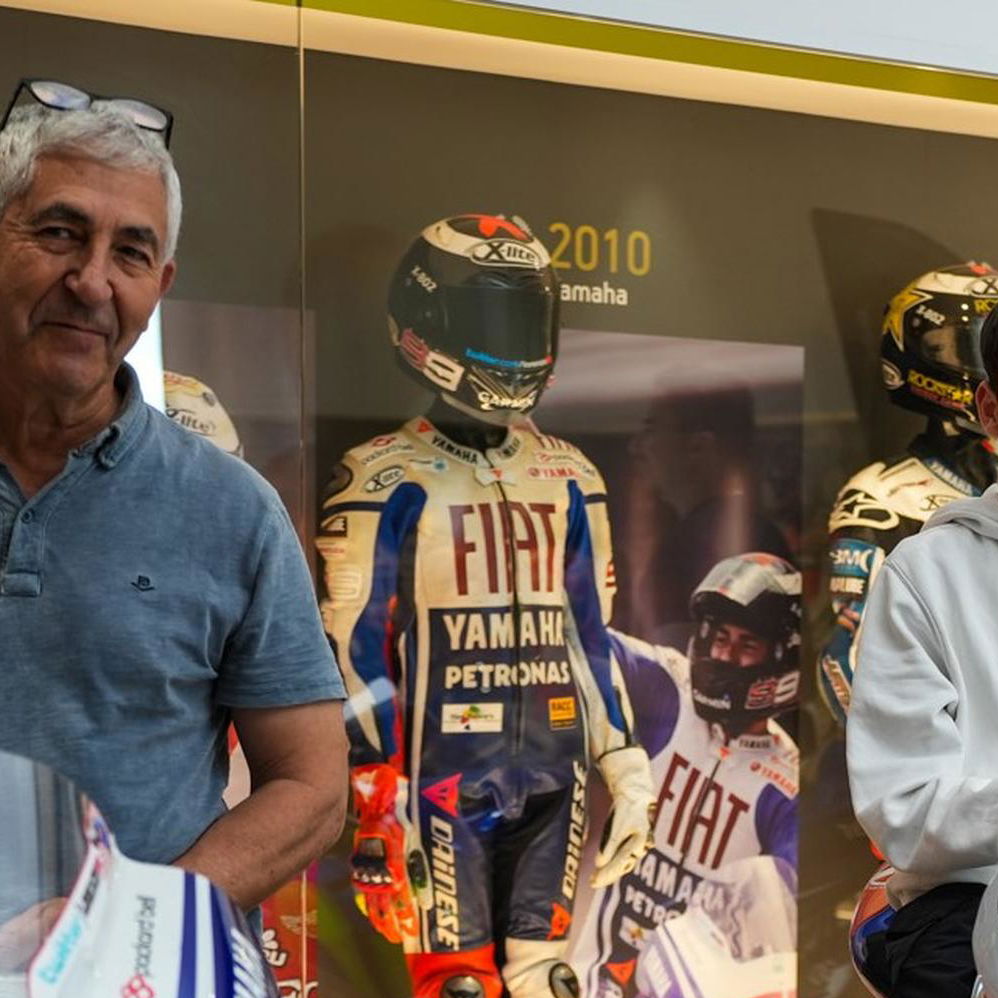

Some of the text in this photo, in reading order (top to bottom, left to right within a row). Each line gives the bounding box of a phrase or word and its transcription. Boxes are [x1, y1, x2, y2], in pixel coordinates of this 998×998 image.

[547, 222, 651, 277] 2010
[560, 282, 629, 306] amaha
[431, 436, 479, 465] YAMAHA
[448, 501, 556, 597] FIAT
[442, 611, 565, 651] YAMAHA
[444, 660, 571, 690] PETRONAS
[561, 760, 588, 900] DAINESE
[652, 752, 750, 870] FIAT
[429, 814, 462, 950] DAINESE
